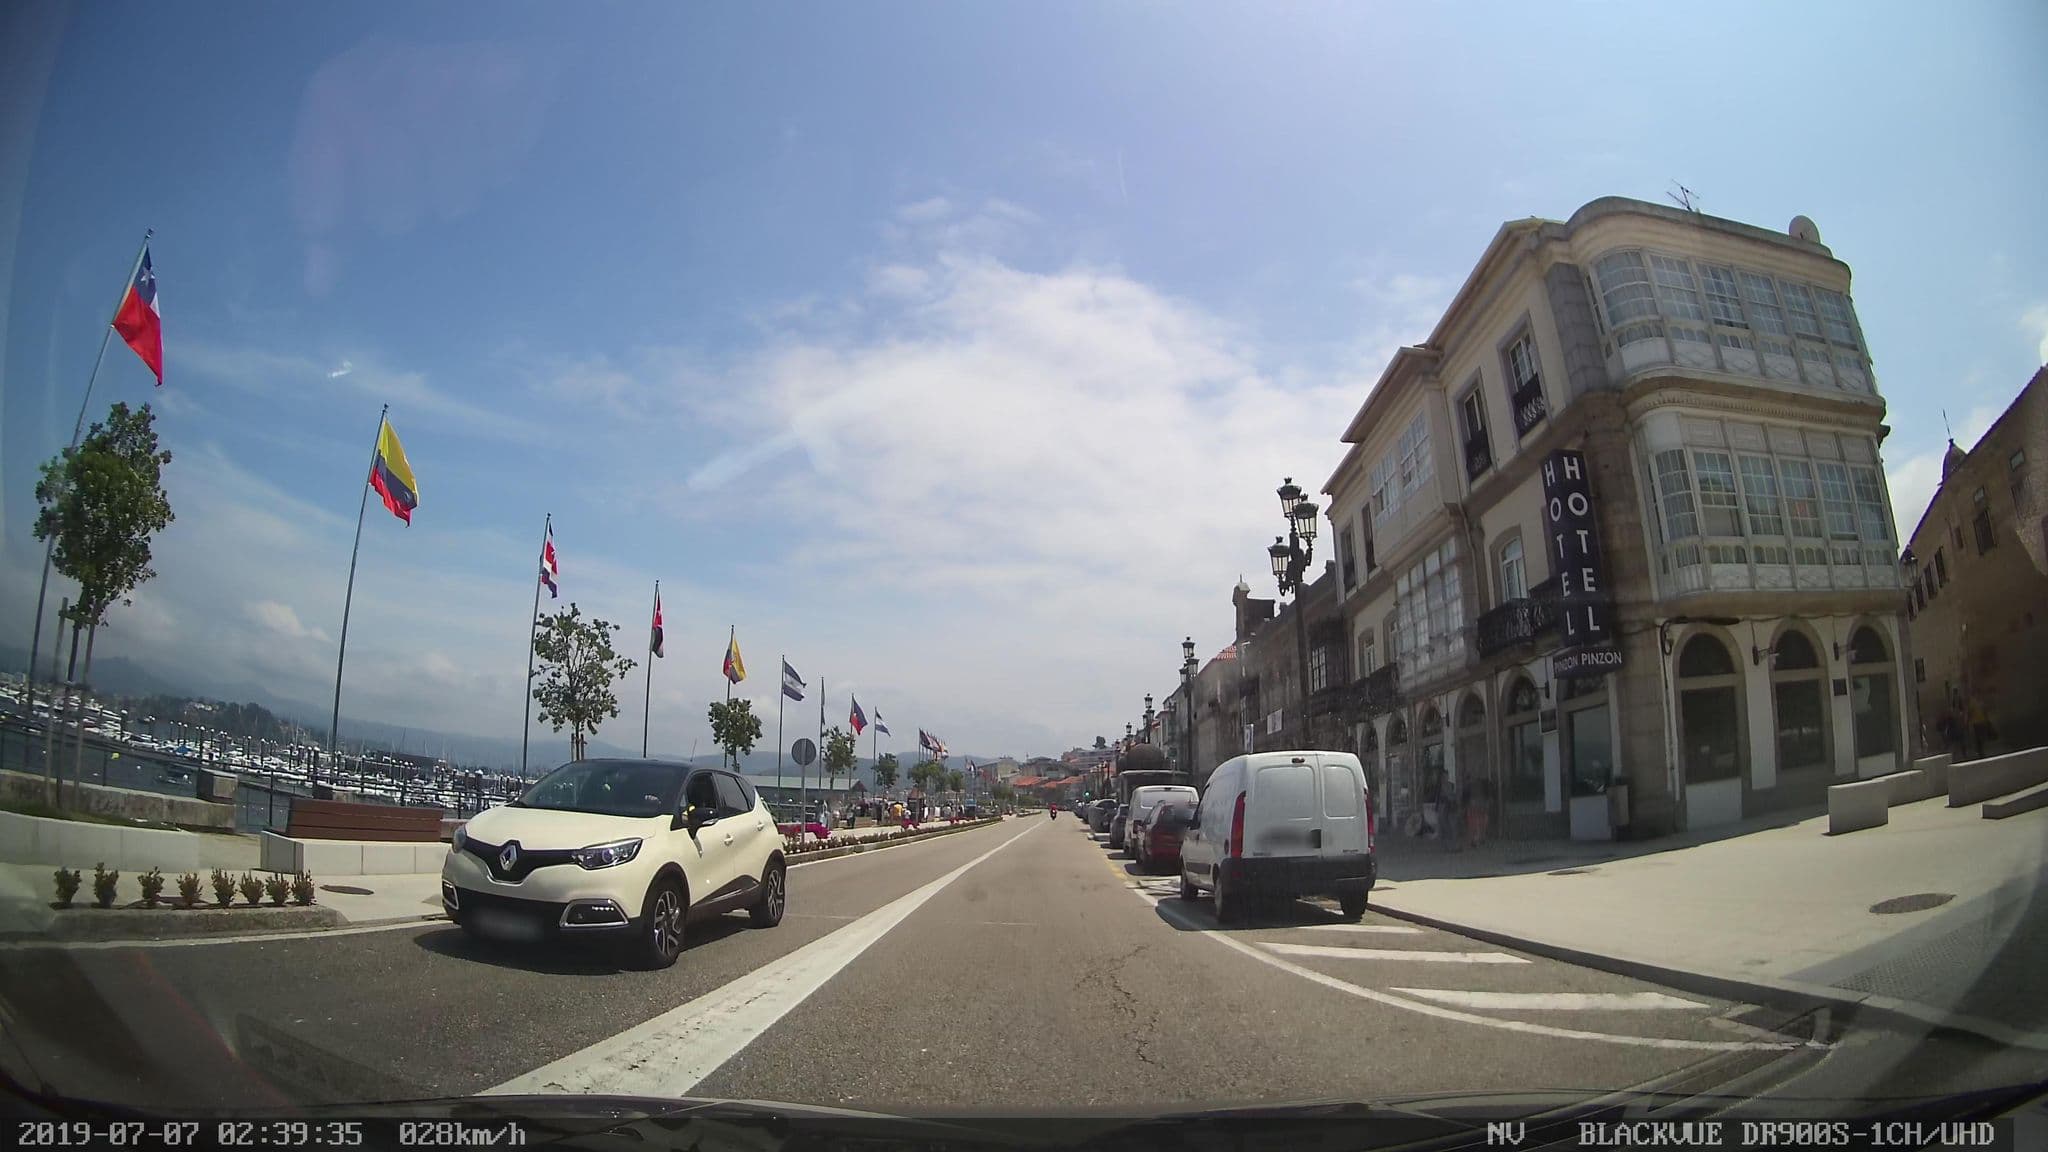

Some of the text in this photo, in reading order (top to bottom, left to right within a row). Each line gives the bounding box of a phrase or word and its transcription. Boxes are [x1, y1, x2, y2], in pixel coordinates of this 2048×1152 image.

[1544, 460, 1575, 636] HOTEL
[1563, 456, 1600, 631] HOTEL
[1581, 651, 1622, 665] PINZON
